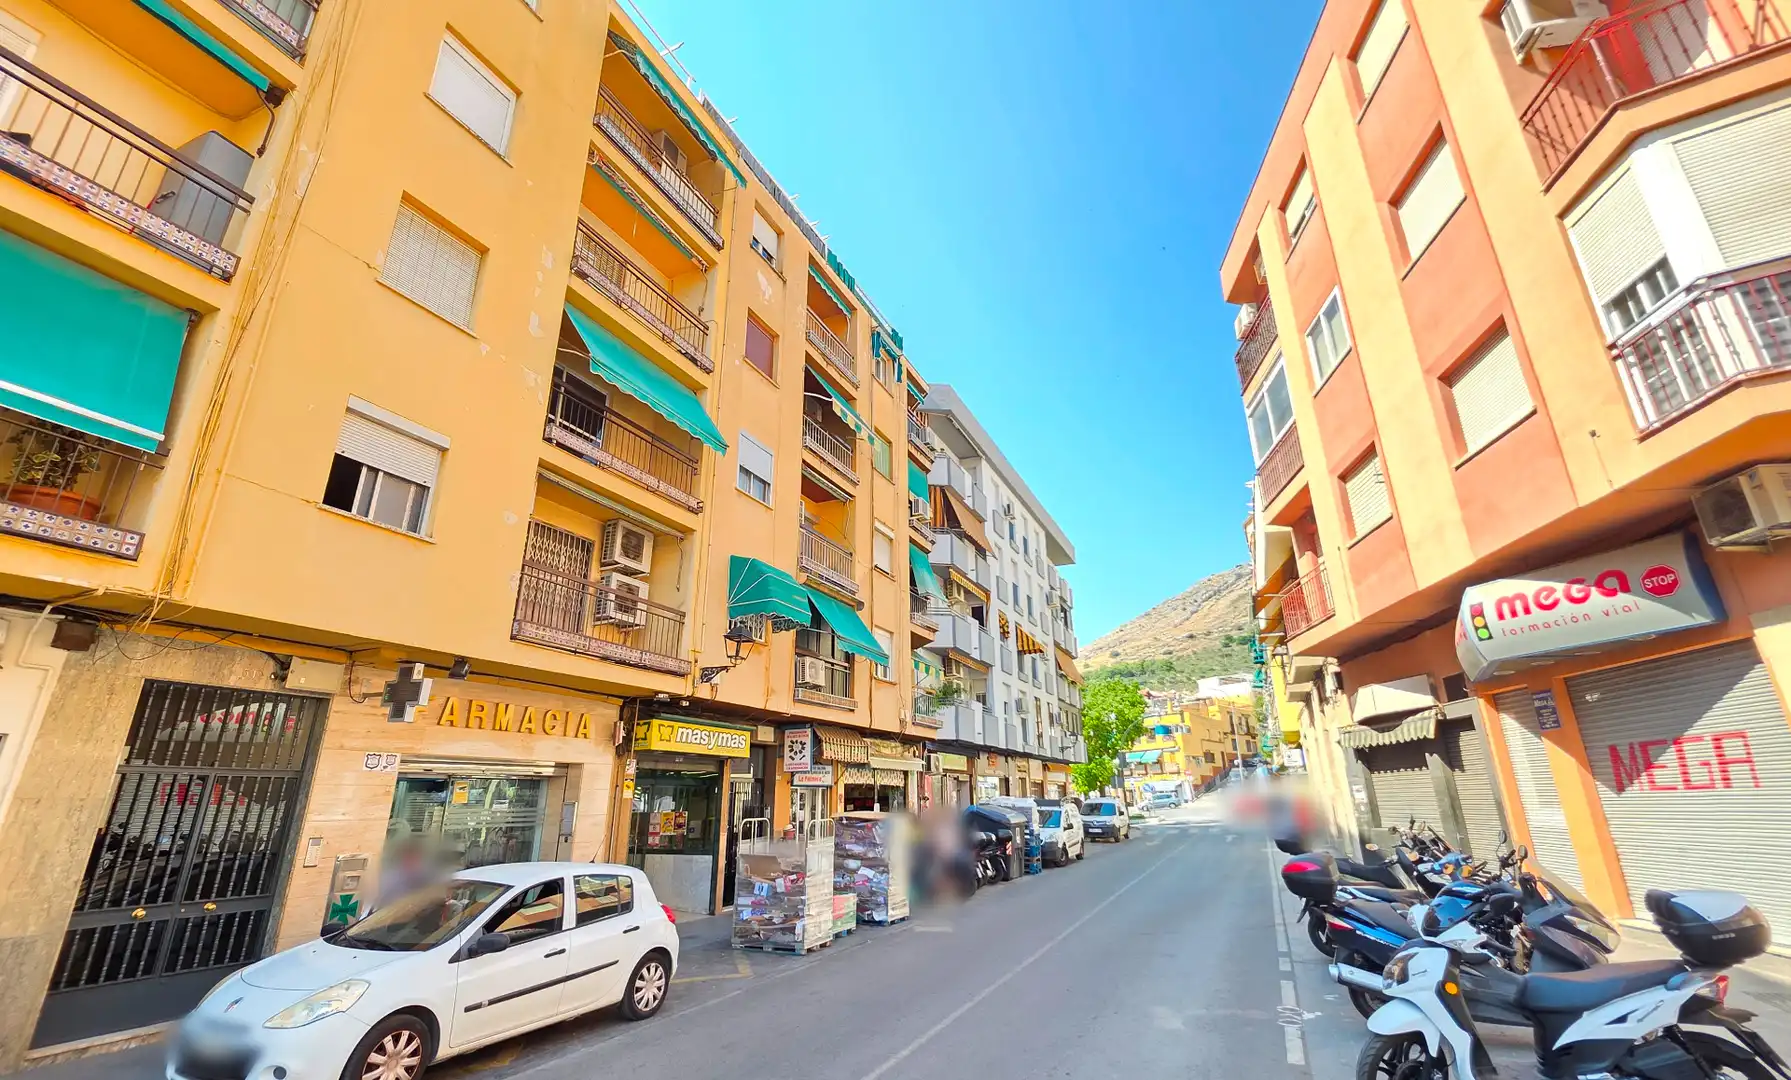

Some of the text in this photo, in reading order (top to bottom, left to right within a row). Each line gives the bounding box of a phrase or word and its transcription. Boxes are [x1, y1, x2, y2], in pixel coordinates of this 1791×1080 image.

[1643, 573, 1676, 589] STOP
[1501, 600, 1641, 637] formación vial
[675, 726, 747, 749] masymas
[1607, 730, 1763, 793] MEGA
